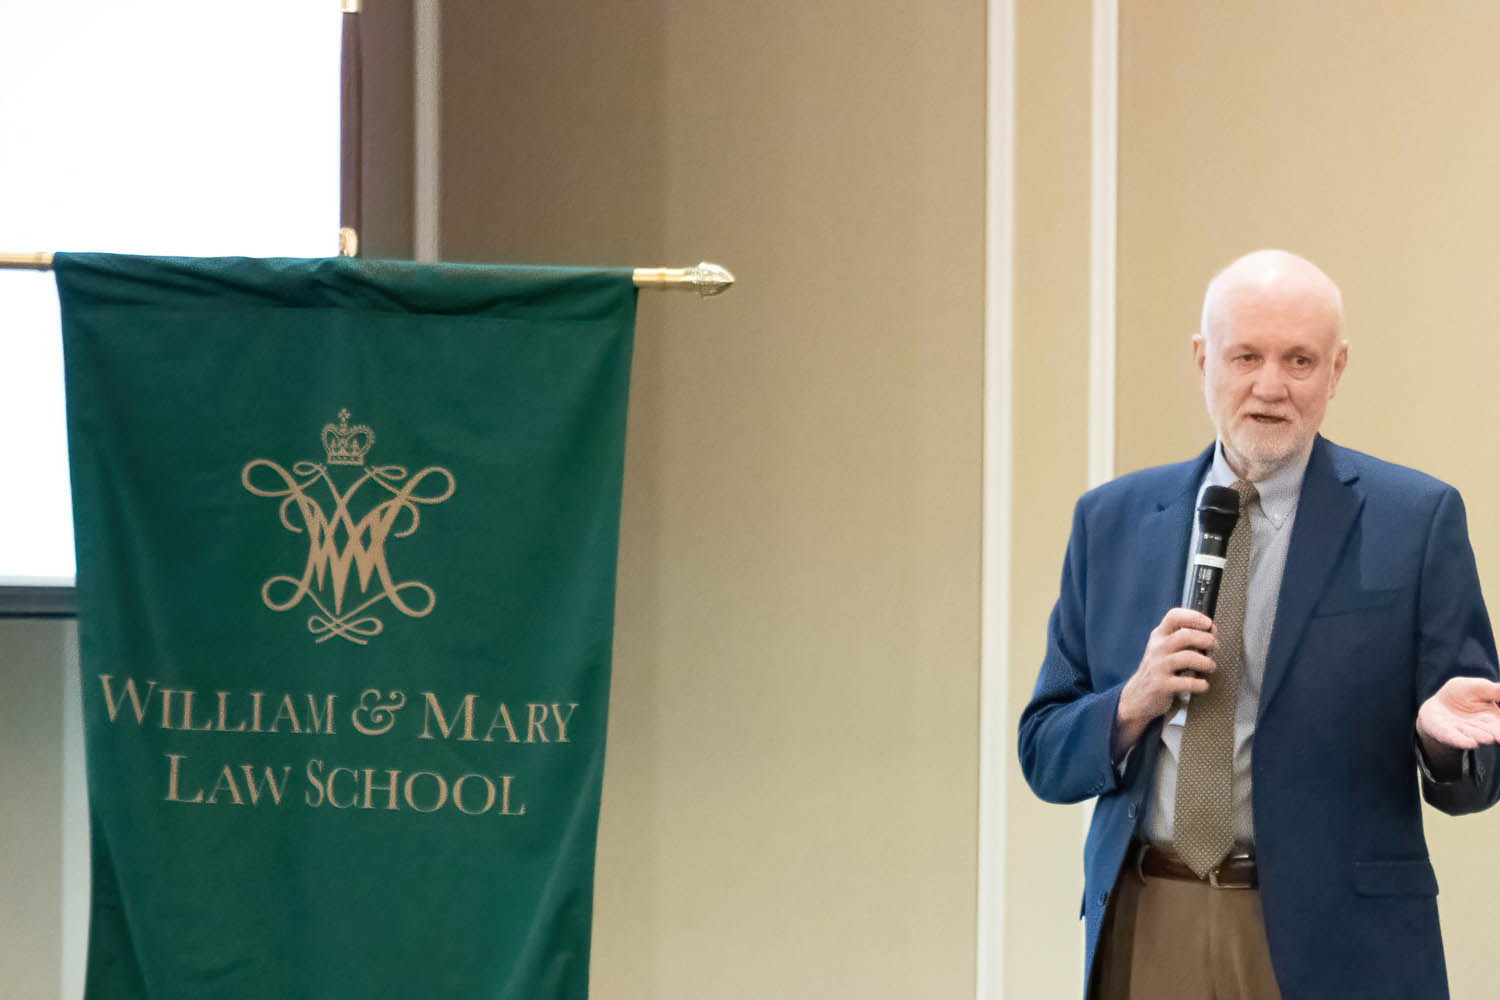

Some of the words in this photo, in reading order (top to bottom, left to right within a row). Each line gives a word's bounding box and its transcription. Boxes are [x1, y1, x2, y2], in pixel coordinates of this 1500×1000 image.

[98, 673, 337, 735] WILLIAM
[351, 688, 406, 735] &
[418, 691, 580, 744] MARY
[164, 753, 292, 805] LAW
[304, 758, 526, 816] SCHOOL
